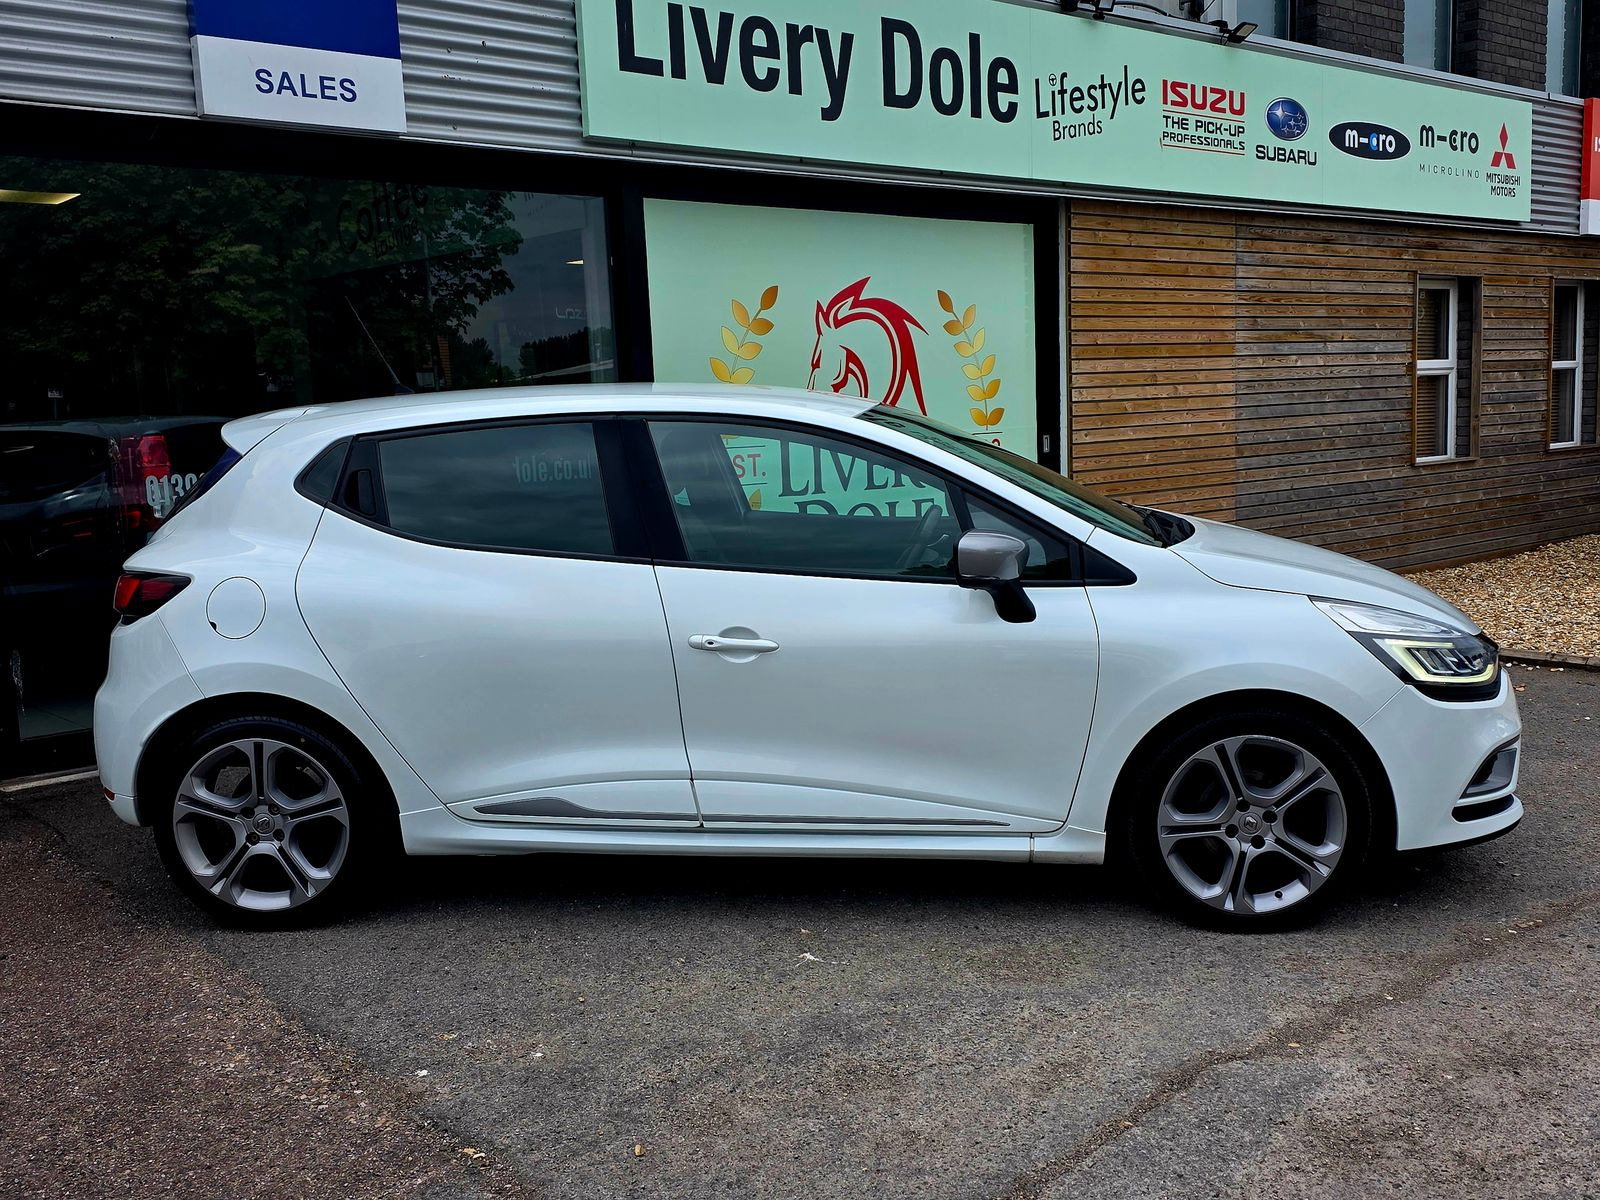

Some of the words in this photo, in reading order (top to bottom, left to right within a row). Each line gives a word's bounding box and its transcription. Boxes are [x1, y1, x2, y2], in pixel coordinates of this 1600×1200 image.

[615, 0, 854, 121] Livery
[880, 16, 1019, 124] Dole
[255, 68, 358, 102] SALES
[1034, 64, 1146, 119] Lifestyle
[1162, 79, 1245, 116] ISUZU
[1052, 113, 1104, 142] Brands
[1162, 114, 1190, 131] THE
[1194, 118, 1246, 138] PICK-UP
[1162, 131, 1246, 151] PROFESSIONALS
[1255, 144, 1318, 167] SUBARU
[1419, 163, 1480, 179] MICROLINO
[1485, 172, 1521, 186] MITSUBISHI
[1490, 185, 1517, 198] MOTORS
[732, 453, 768, 480] ST.
